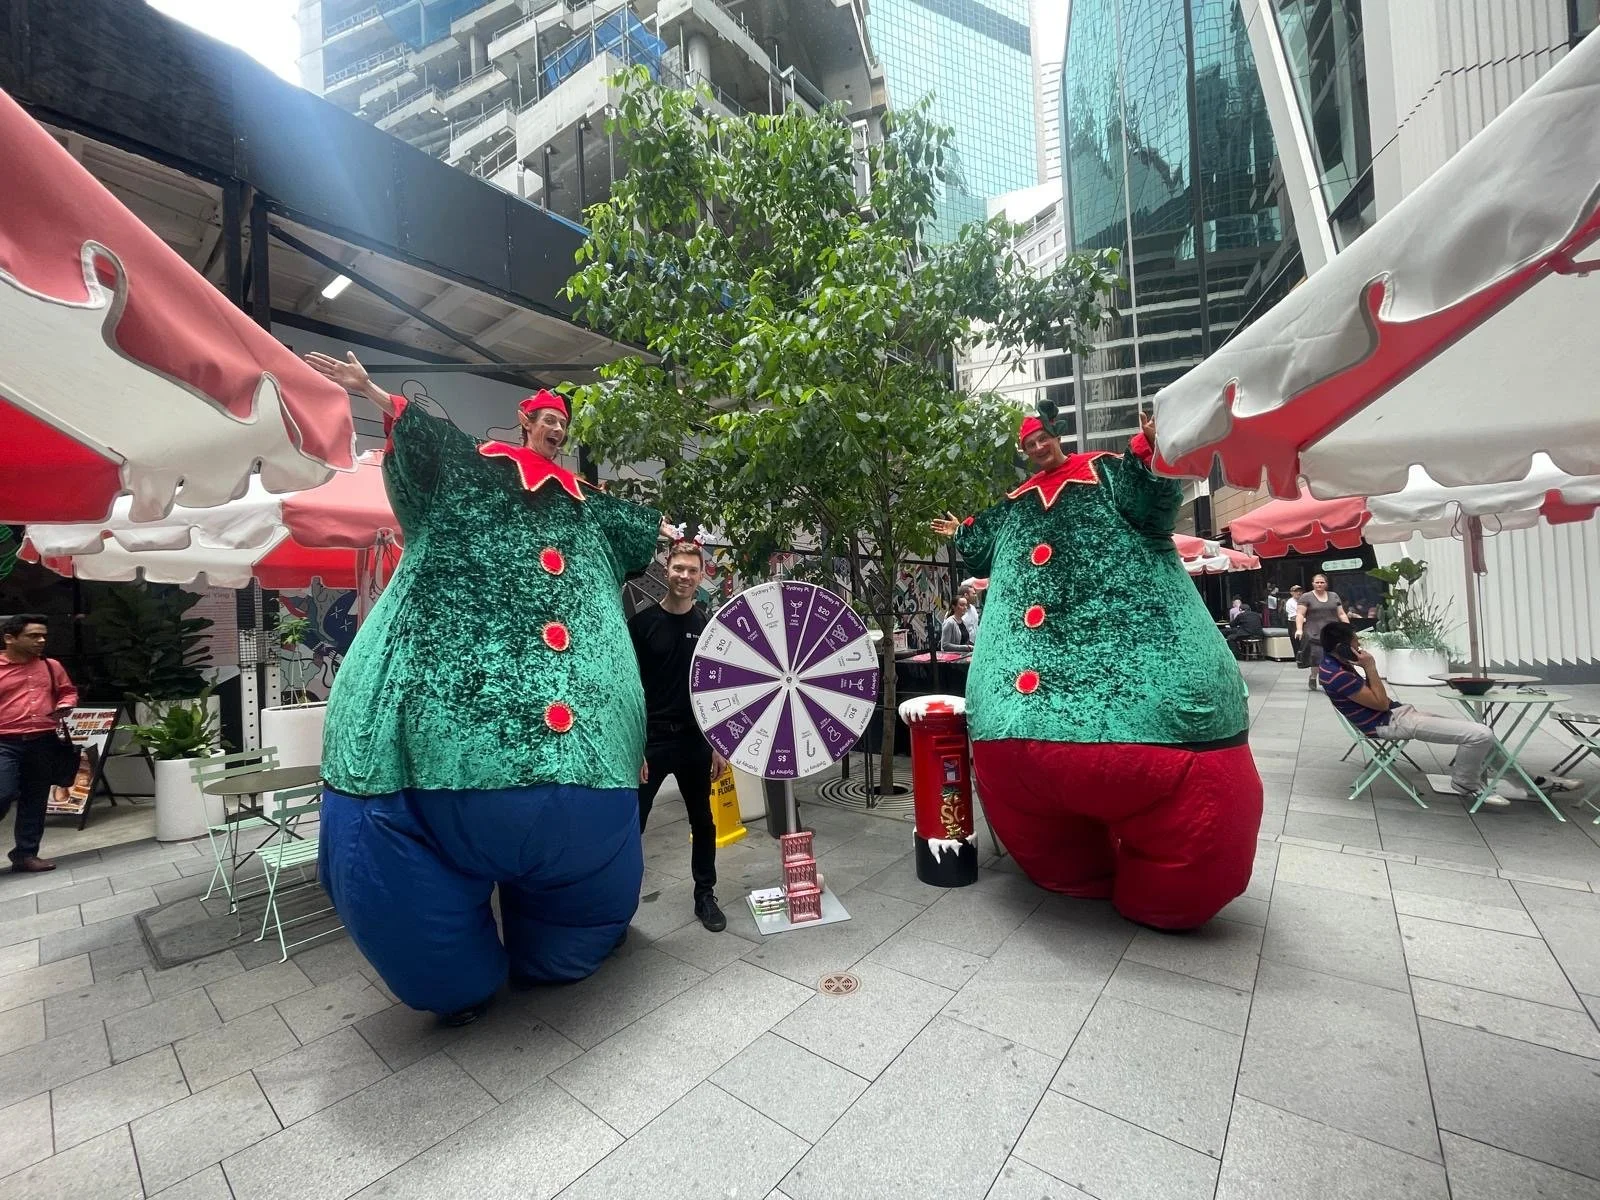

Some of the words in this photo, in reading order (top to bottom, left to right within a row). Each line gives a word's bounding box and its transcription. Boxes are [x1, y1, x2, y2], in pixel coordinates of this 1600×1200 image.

[818, 606, 830, 616] $20
[716, 639, 726, 652] $10
[709, 670, 716, 680] $5
[849, 707, 858, 719] $10
[720, 777, 731, 787] WET
[718, 784, 735, 796] FLOOR
